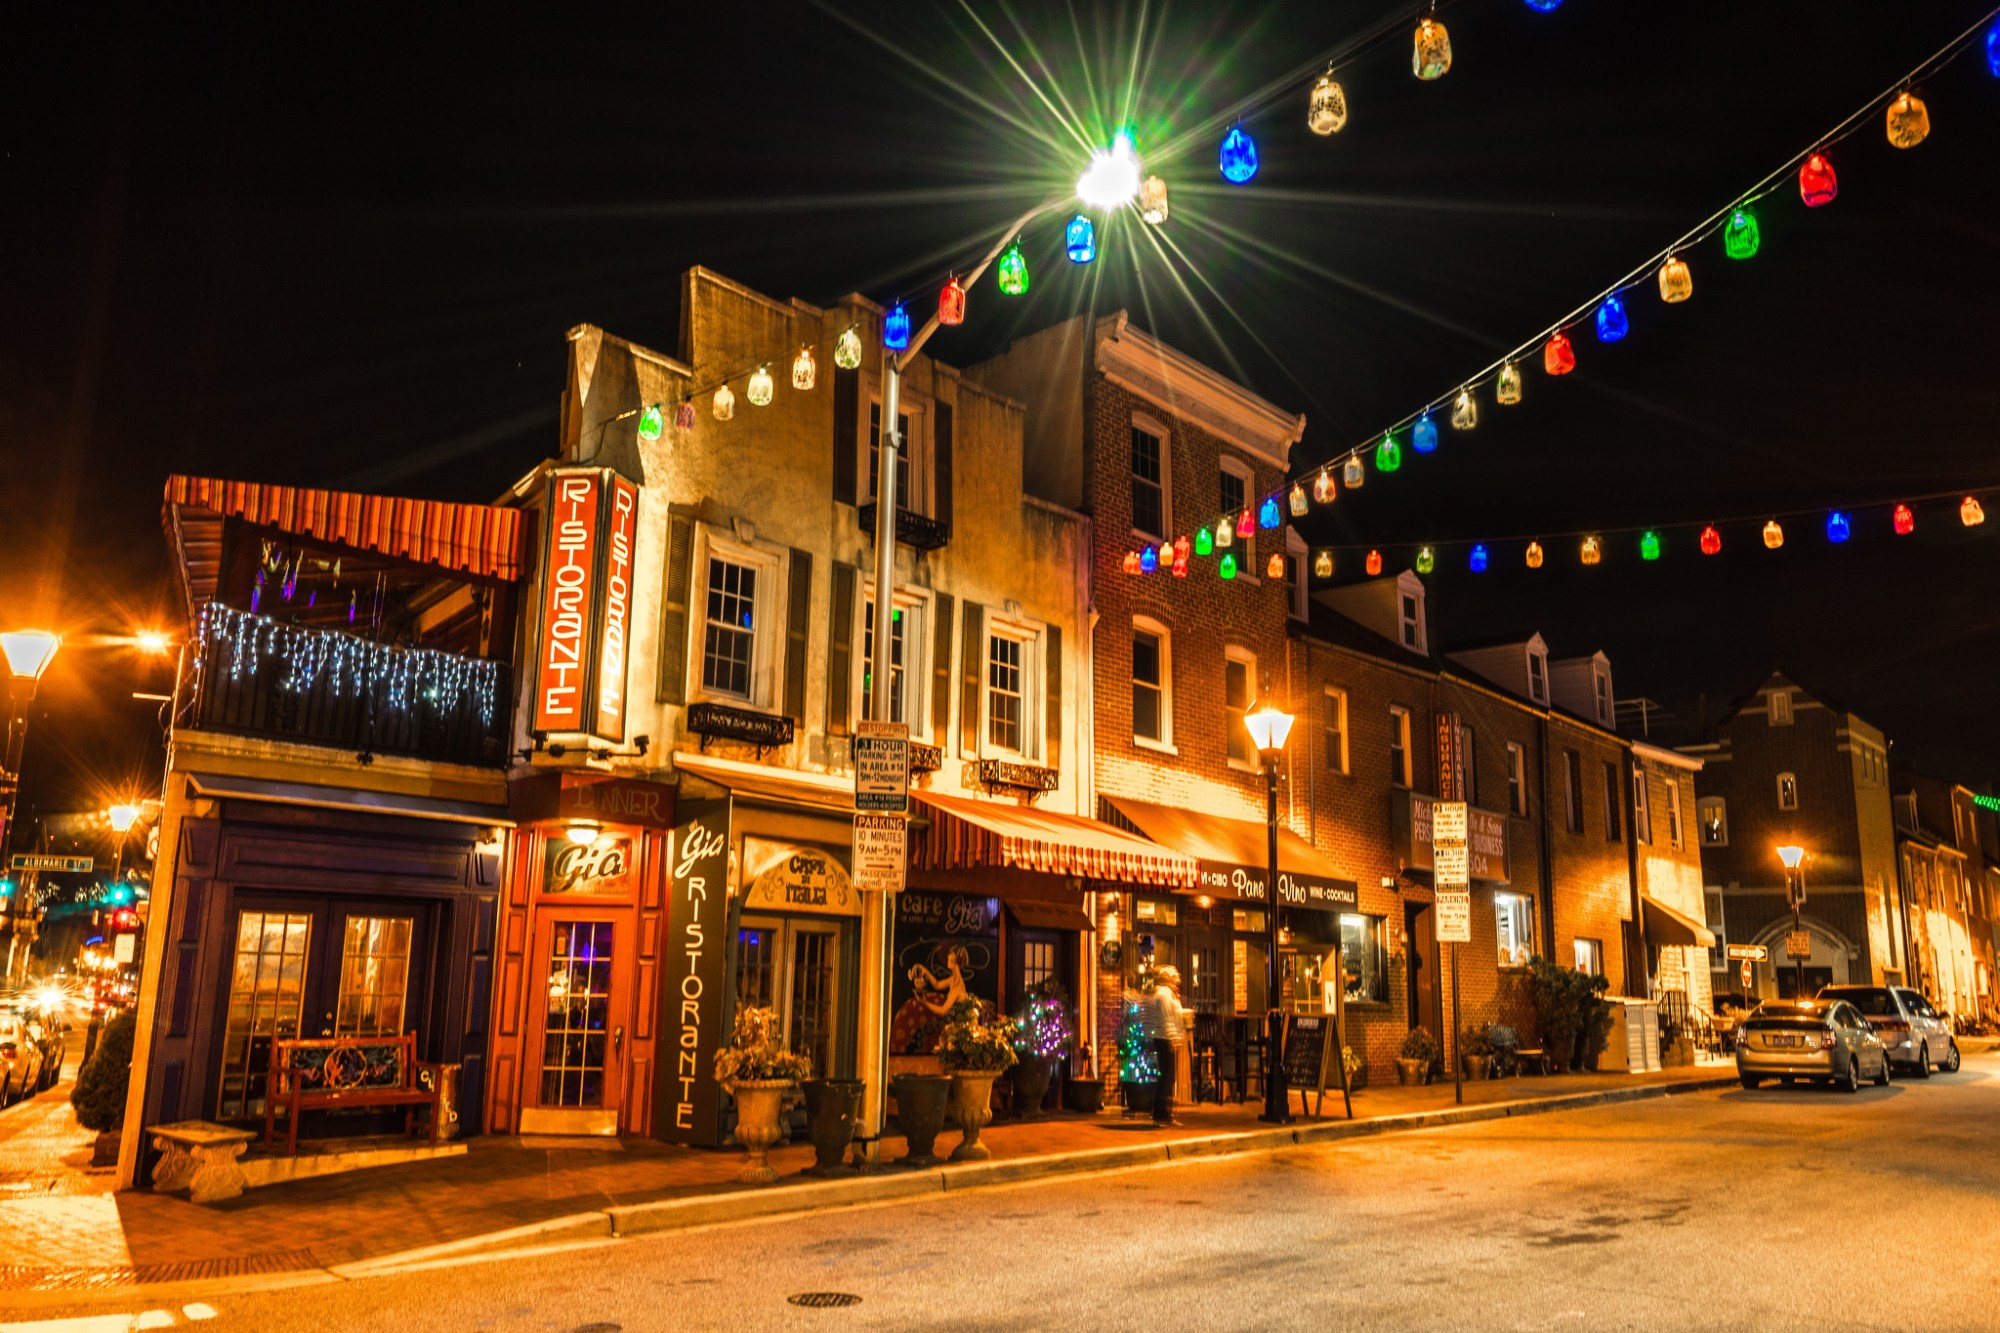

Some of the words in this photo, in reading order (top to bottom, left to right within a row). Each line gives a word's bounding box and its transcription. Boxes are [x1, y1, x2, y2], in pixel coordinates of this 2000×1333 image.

[874, 741, 903, 751] HOUR
[860, 751, 886, 760] PARKING
[889, 753, 904, 761] LIMIT
[1440, 715, 1451, 800] INSURANCE
[860, 762, 867, 771] IN
[870, 762, 889, 772] AREA
[858, 817, 903, 830] PARKING
[1415, 820, 1433, 842] PERS
[1487, 817, 1502, 836] Sons
[858, 831, 866, 841] 10
[871, 831, 902, 843] MINUTES
[675, 825, 724, 879] Gia
[24, 857, 68, 869] ALBEMARLE
[551, 845, 627, 892] Gia
[860, 870, 898, 879] PASSENGER
[1211, 872, 1228, 888] CIBO
[1232, 868, 1265, 899] Pane
[1278, 874, 1306, 904] Vino
[1309, 886, 1324, 900] WINE
[1326, 888, 1355, 904] COCKTAILS
[945, 894, 984, 935] Gia
